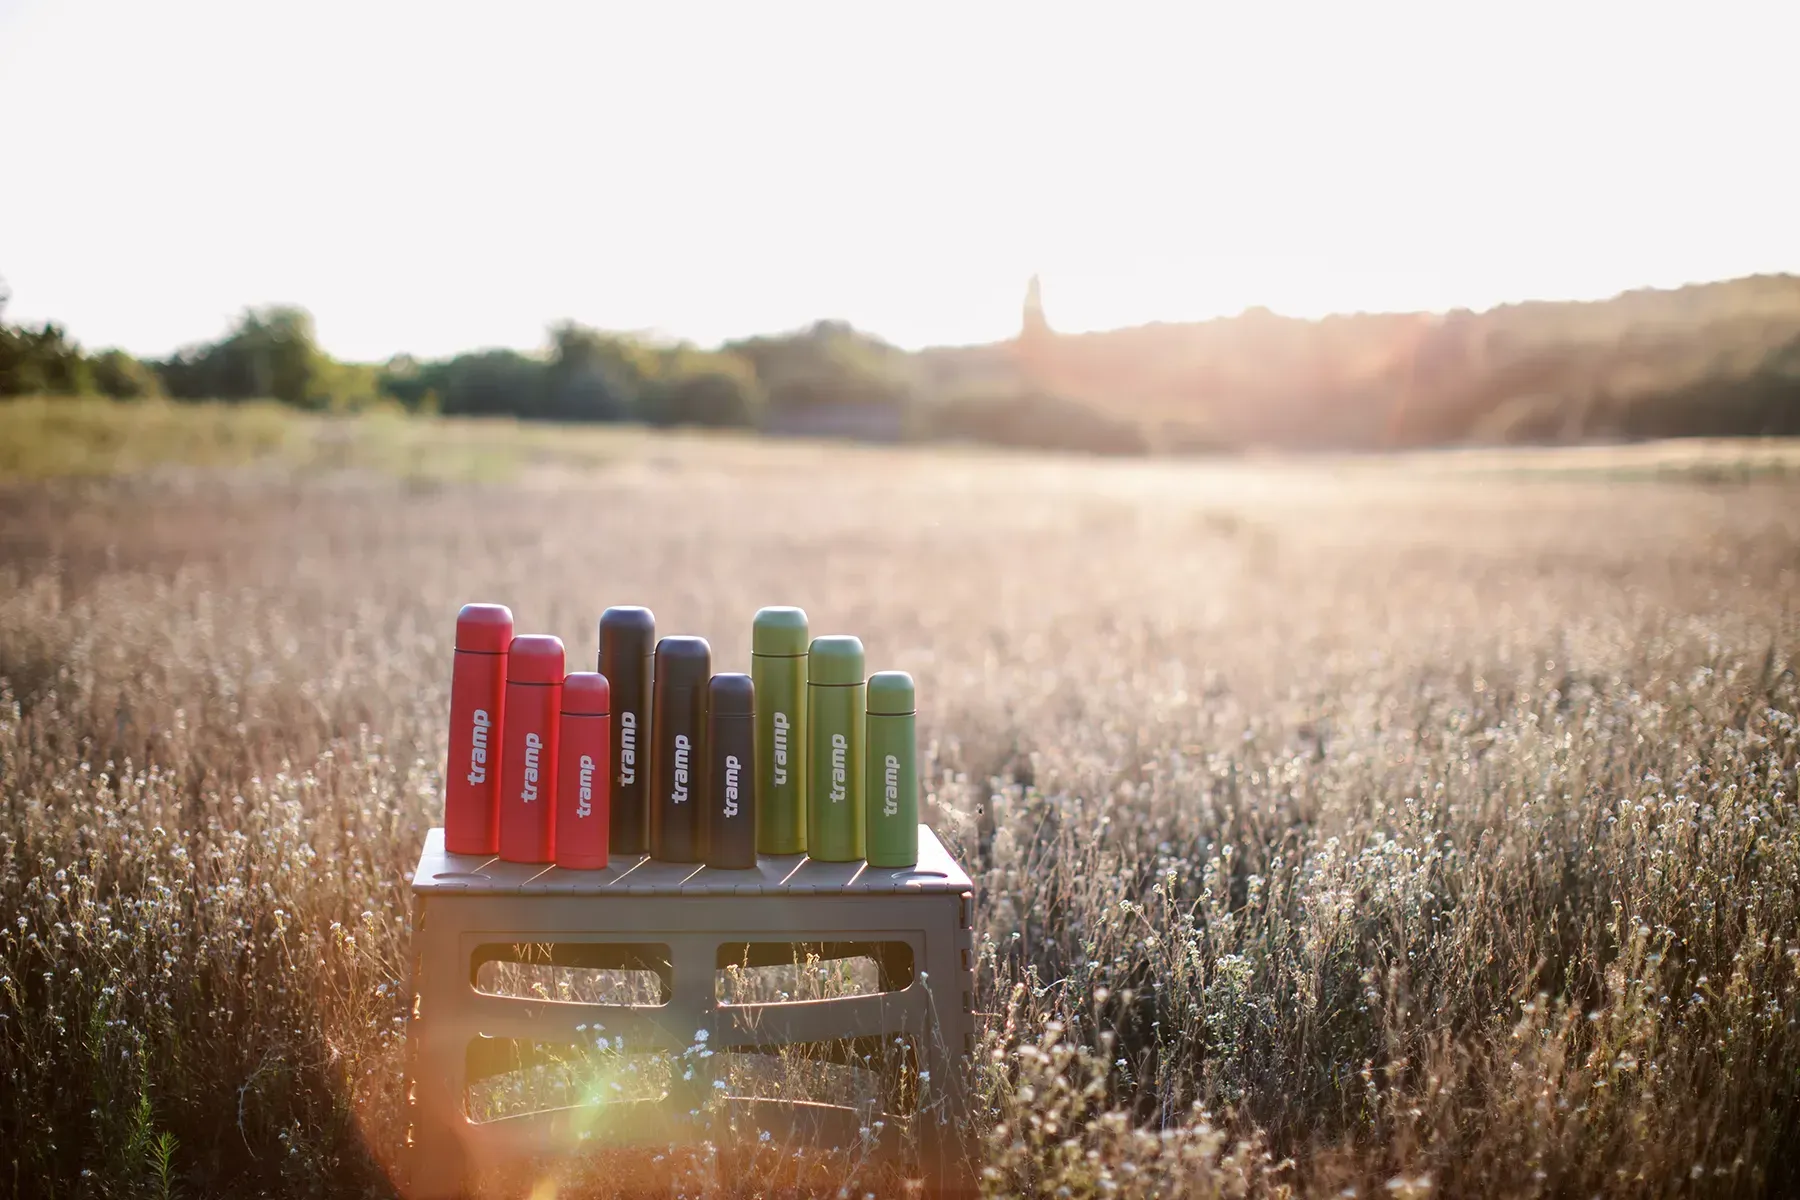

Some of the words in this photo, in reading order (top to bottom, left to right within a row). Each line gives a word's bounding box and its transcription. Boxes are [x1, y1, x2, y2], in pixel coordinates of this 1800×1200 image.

[467, 709, 491, 786] tramp
[520, 732, 543, 803] tramp
[617, 711, 637, 787] tramp
[671, 734, 692, 804] tramp
[773, 711, 790, 787] tramp
[829, 733, 848, 803] tramp
[576, 755, 595, 818] tramp
[723, 755, 742, 818] tramp
[883, 754, 900, 817] tramp
